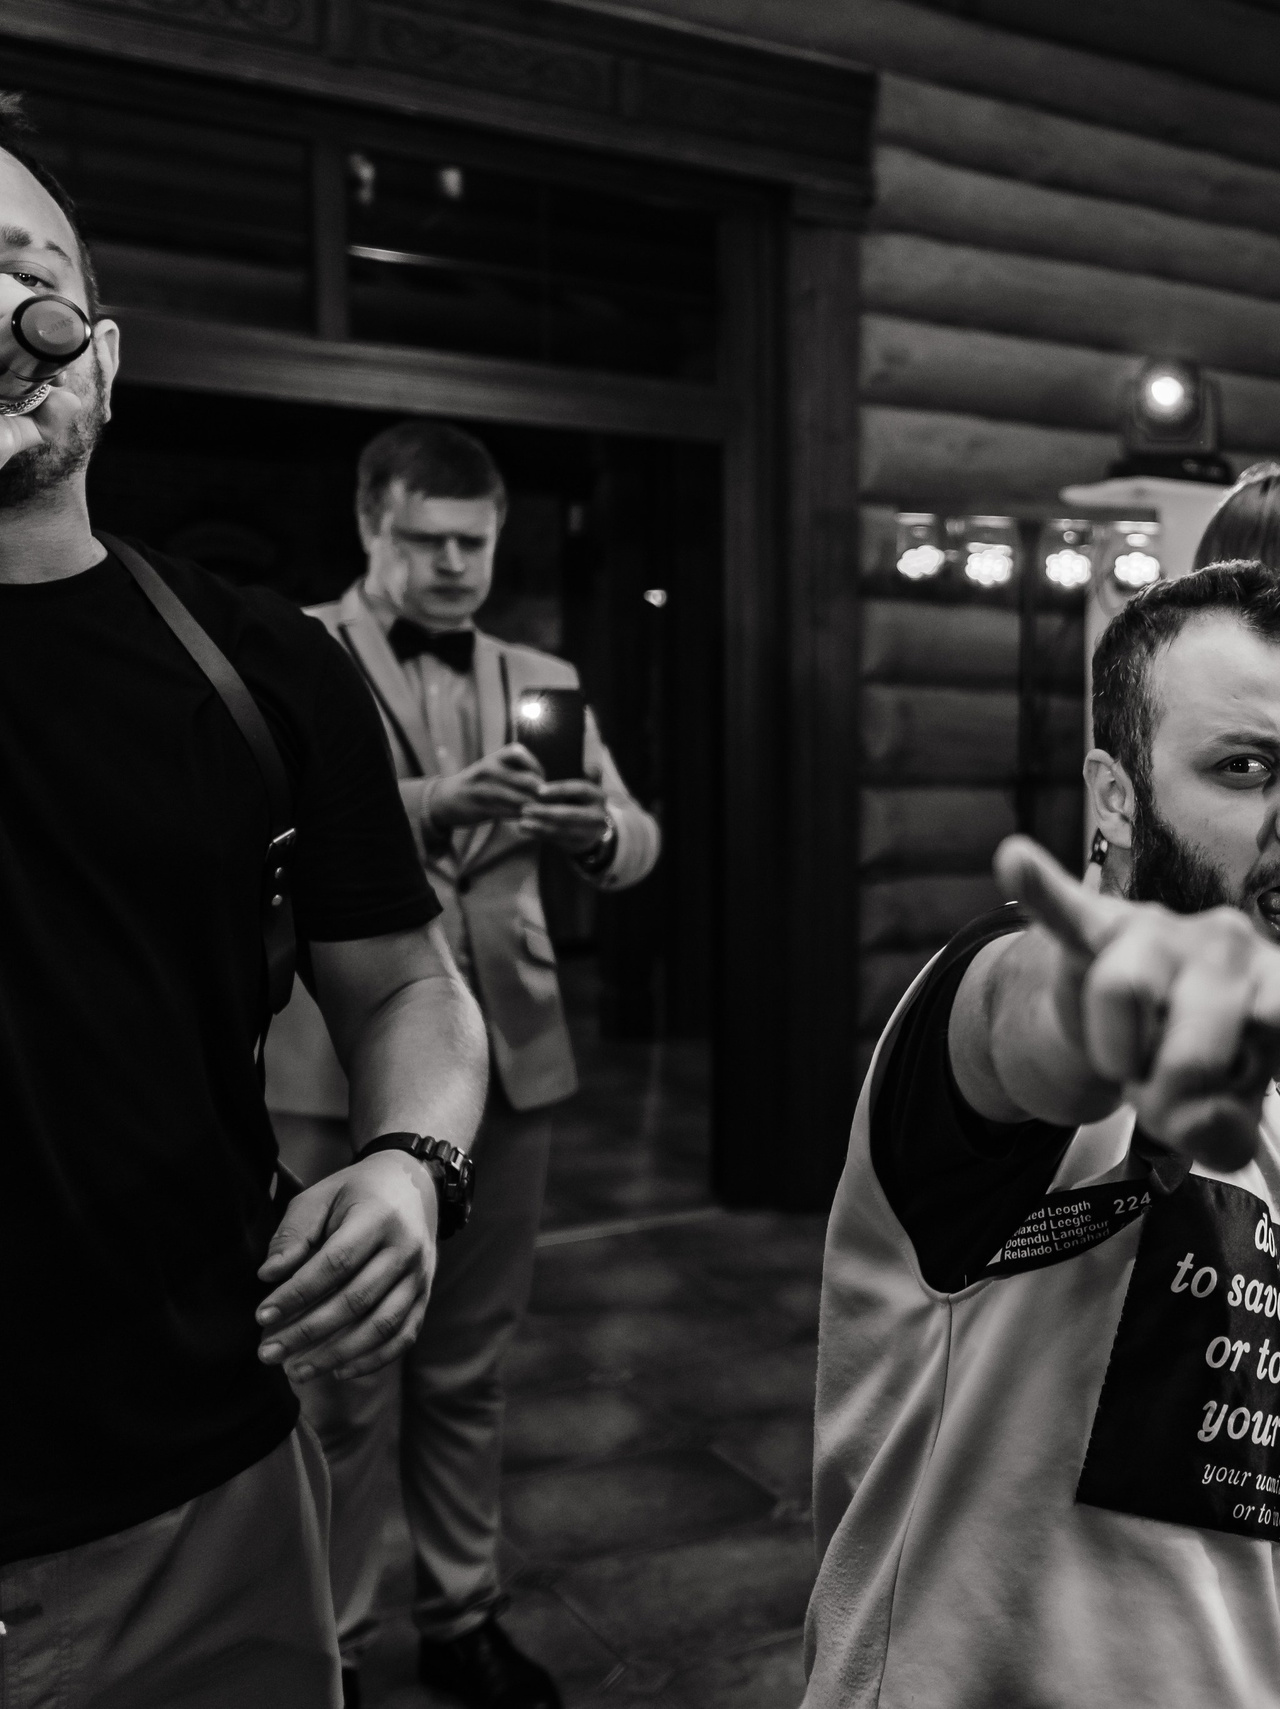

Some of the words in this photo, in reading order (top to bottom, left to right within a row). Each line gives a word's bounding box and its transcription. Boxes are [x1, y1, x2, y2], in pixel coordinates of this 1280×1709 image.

[1112, 1191, 1152, 1215] 224
[1170, 1252, 1218, 1299] to
[1205, 1335, 1251, 1373] or
[1201, 1463, 1252, 1488] your
[1232, 1503, 1256, 1521] or
[1257, 1503, 1273, 1525] to
